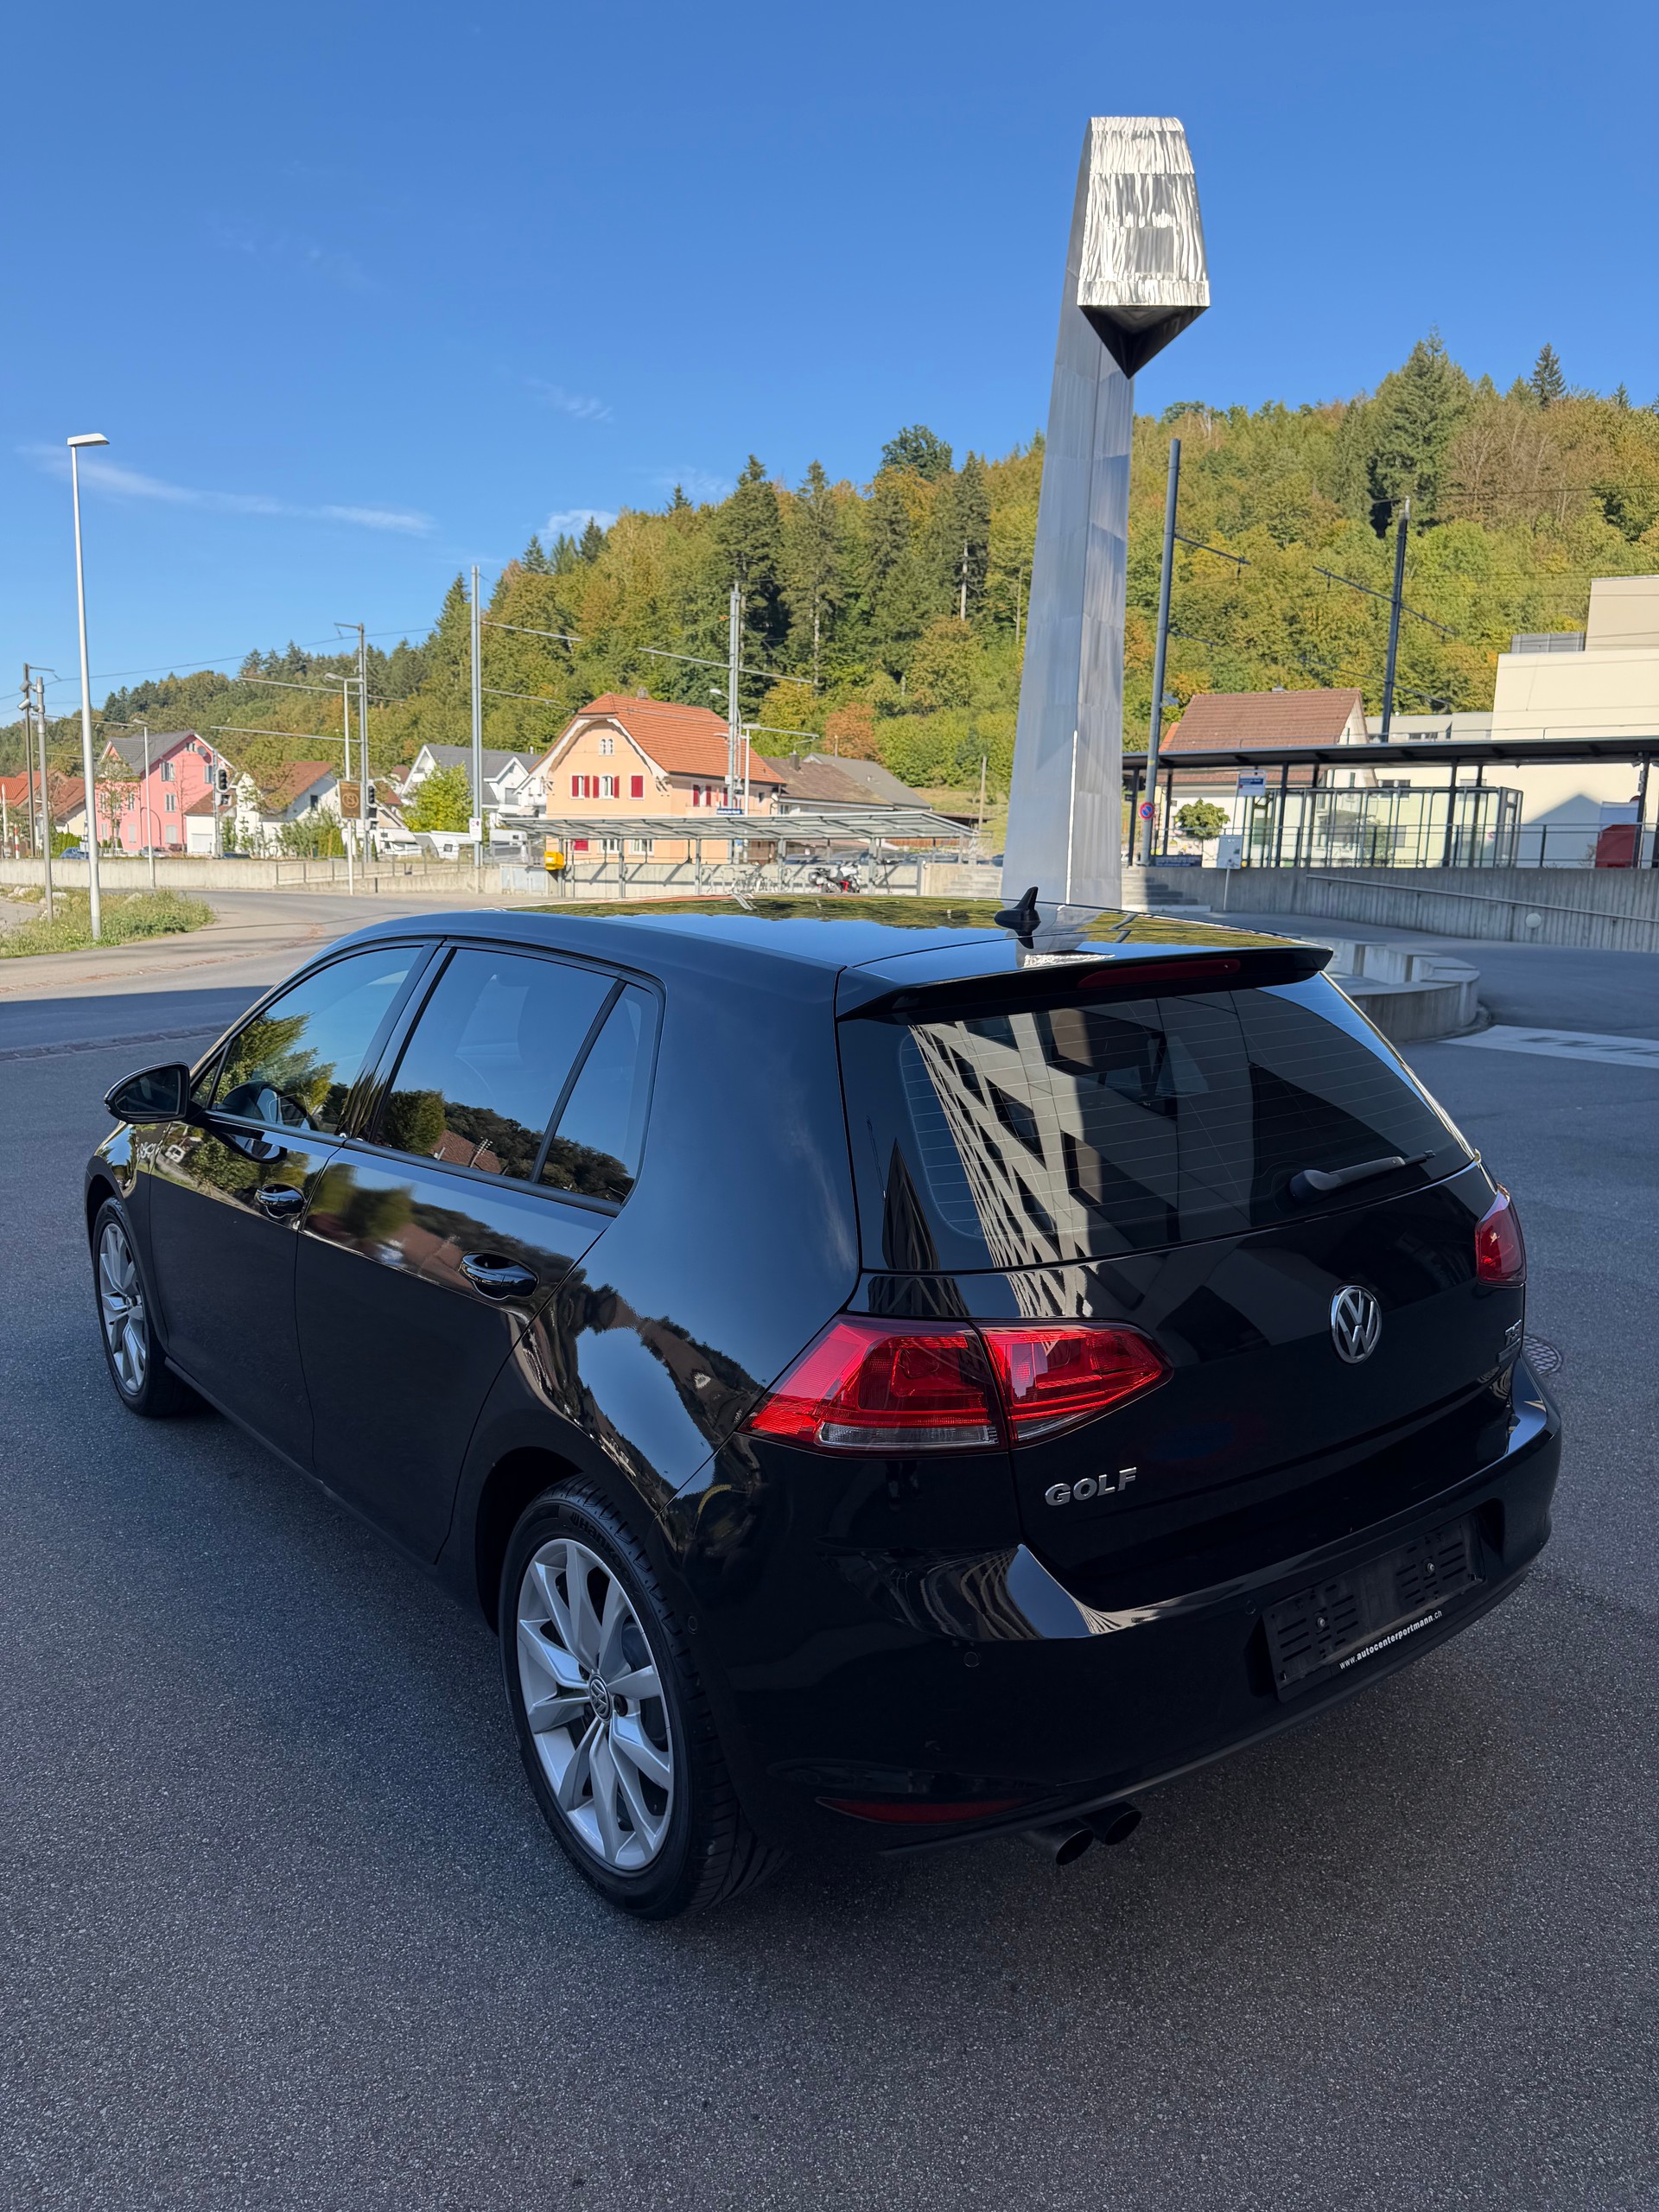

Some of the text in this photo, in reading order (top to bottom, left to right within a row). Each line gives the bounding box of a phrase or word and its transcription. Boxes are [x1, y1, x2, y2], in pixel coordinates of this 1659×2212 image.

[1332, 1287, 1381, 1363] VW
[1045, 1467, 1137, 1506] GOLF
[1339, 1610, 1443, 1670] www.autocenterportmann.ch
